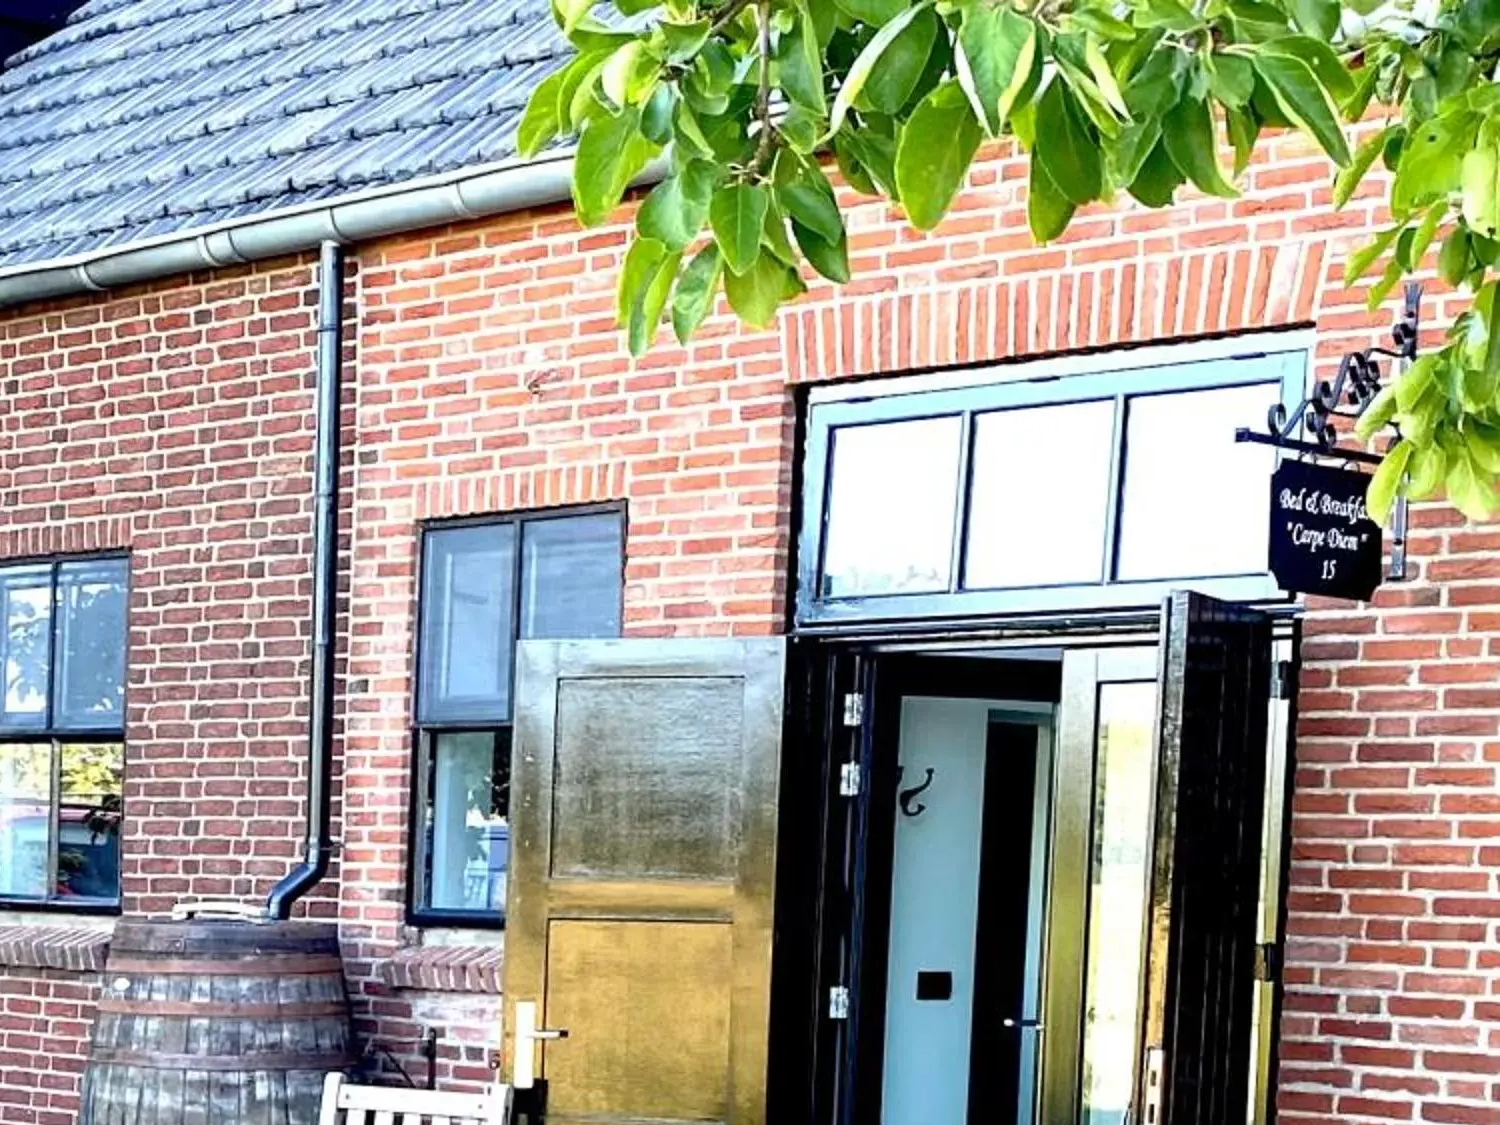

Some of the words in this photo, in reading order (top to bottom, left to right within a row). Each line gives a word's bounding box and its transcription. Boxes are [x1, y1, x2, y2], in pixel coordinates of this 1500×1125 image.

[1279, 488, 1307, 511] Bed
[1305, 490, 1320, 515] &
[1320, 493, 1368, 525] Breakfa
[1287, 521, 1325, 553] "Carpe
[1321, 559, 1337, 580] 15
